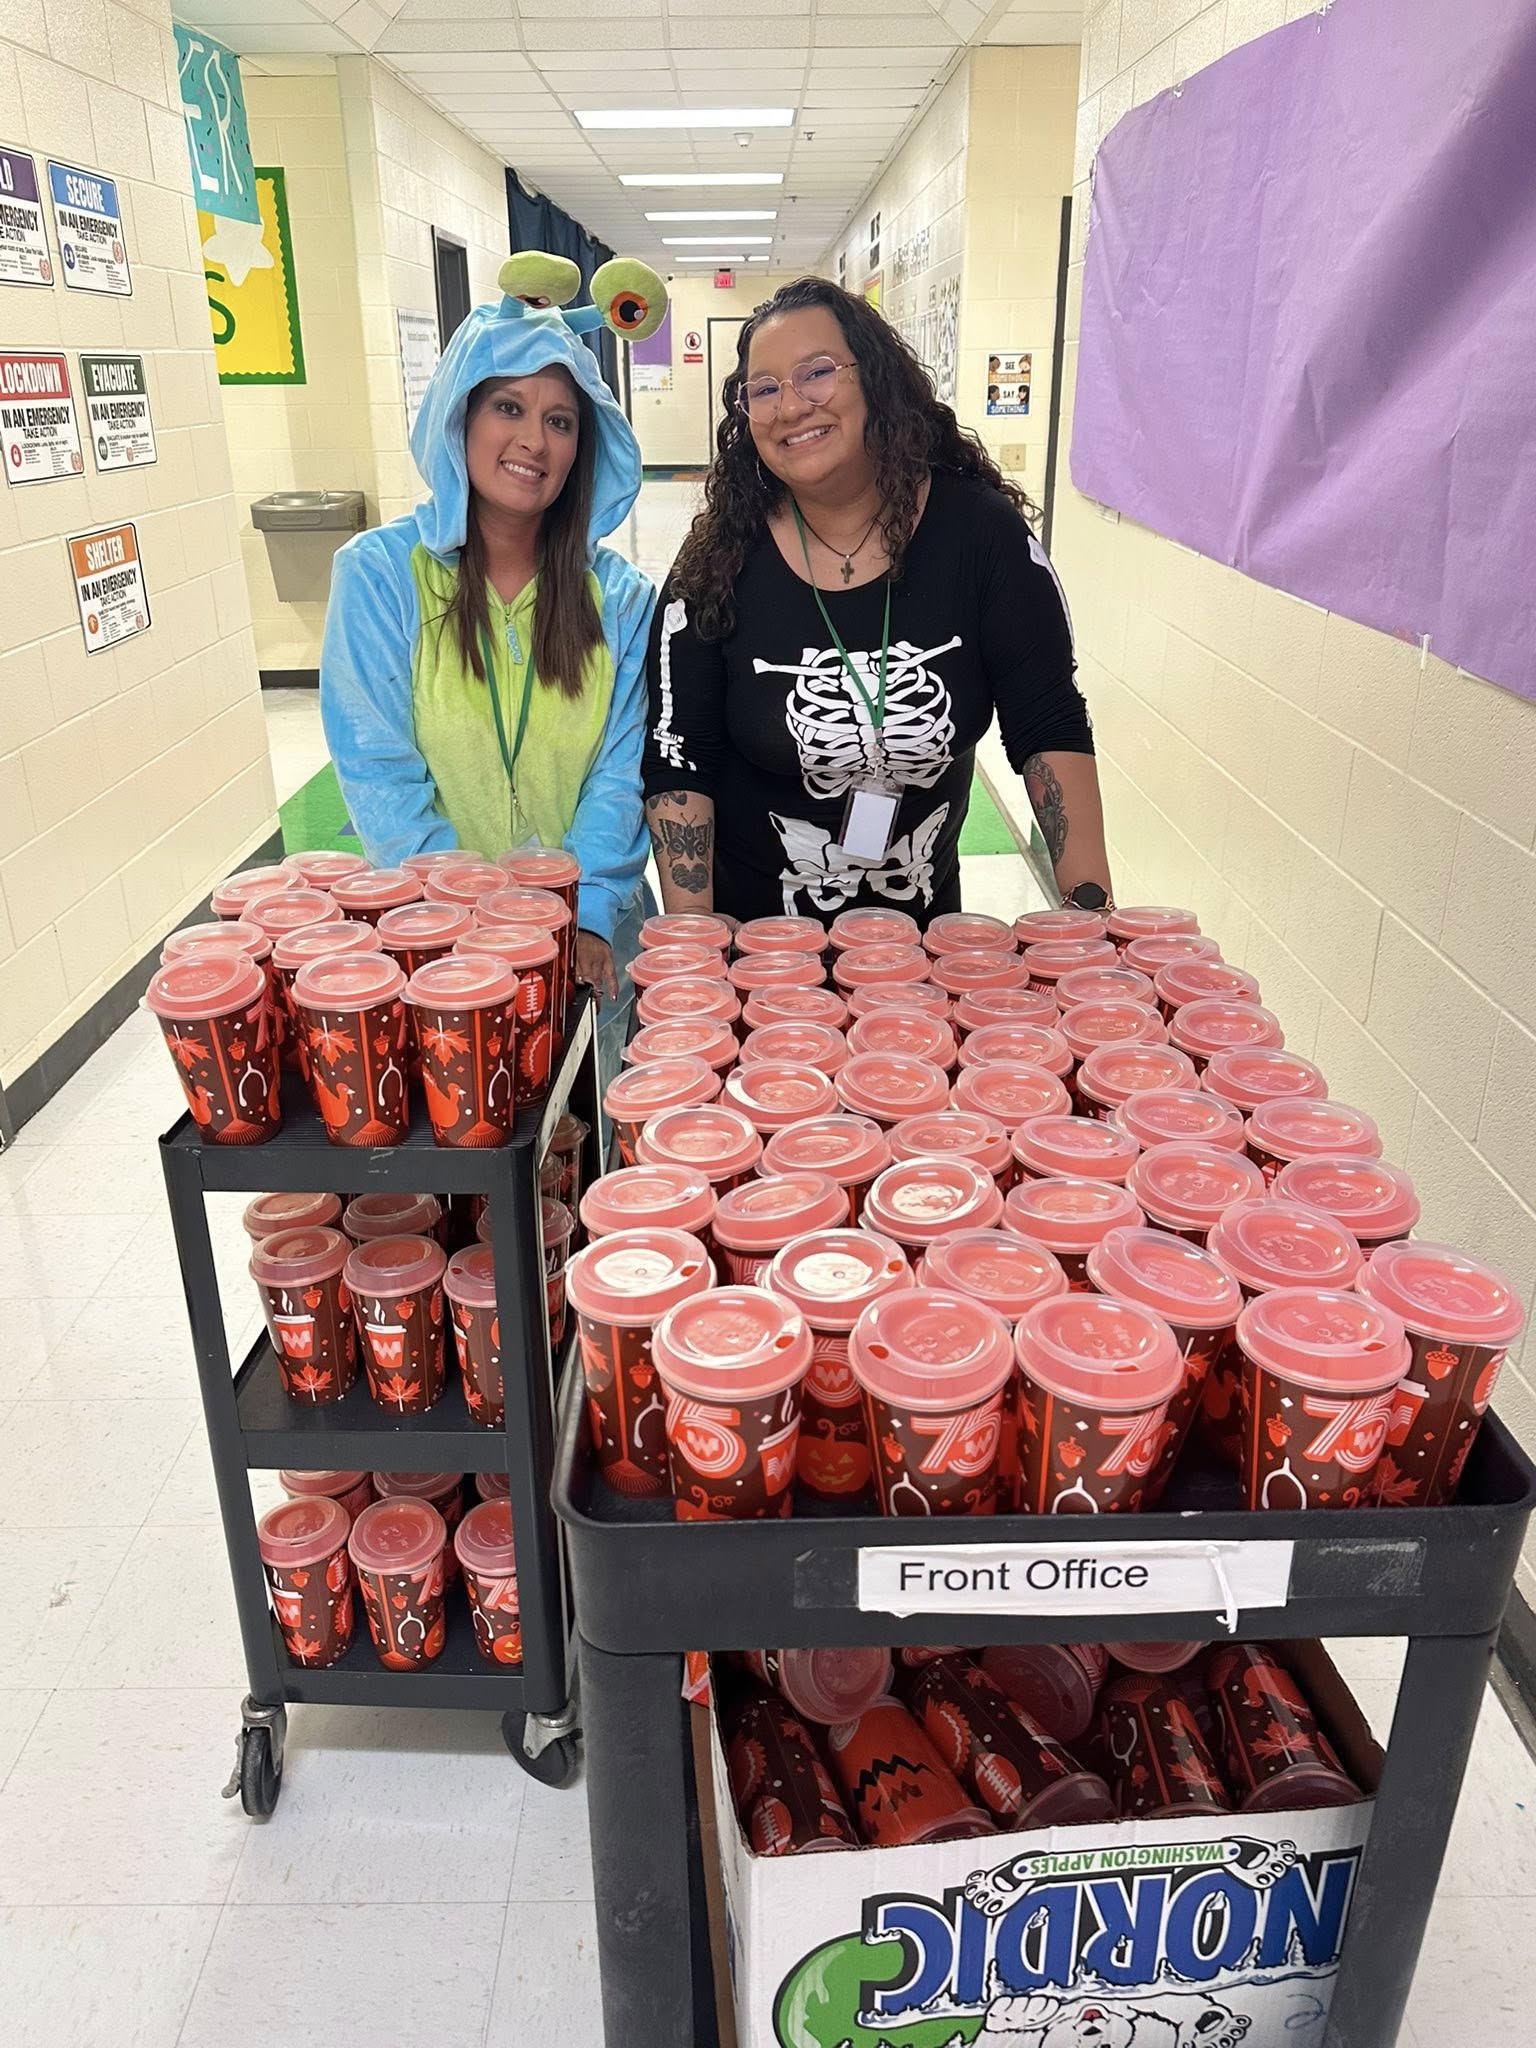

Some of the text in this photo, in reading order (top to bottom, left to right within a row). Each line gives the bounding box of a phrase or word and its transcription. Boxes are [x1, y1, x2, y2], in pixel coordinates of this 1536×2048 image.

[65, 174, 106, 213] SECURE
[6, 227, 26, 242] ACTION
[59, 210, 118, 239] IN AN EMERGENCY
[76, 229, 107, 245] TAKE ACTION
[0, 362, 63, 394] LOCKDOWN
[91, 364, 138, 392] EVACUATE
[1005, 361, 1015, 370] SEE
[1003, 390, 1015, 399] SAY
[1, 406, 70, 429] IN AN EMERGENCY
[91, 401, 146, 421] IN AN EMERGENCY
[107, 419, 136, 431] TAKE ACTION
[22, 427, 58, 440] TAKE ACTION
[85, 534, 126, 571] SHELTER
[81, 567, 137, 602] IN AN EMERGENCY
[100, 588, 128, 607] TAKE ACTION
[280, 1330, 312, 1351] W
[371, 1339, 402, 1361] W
[815, 1365, 849, 1389] W
[686, 1429, 720, 1458] W
[909, 1392, 1002, 1478] 75
[963, 1427, 995, 1458] W
[1302, 1386, 1398, 1474] 75
[1353, 1424, 1385, 1453] W
[899, 1558, 1149, 1591] Front Office
[1030, 1844, 1225, 1876] WASHINGTON APPLES
[879, 1859, 1357, 2015] NORDIC
